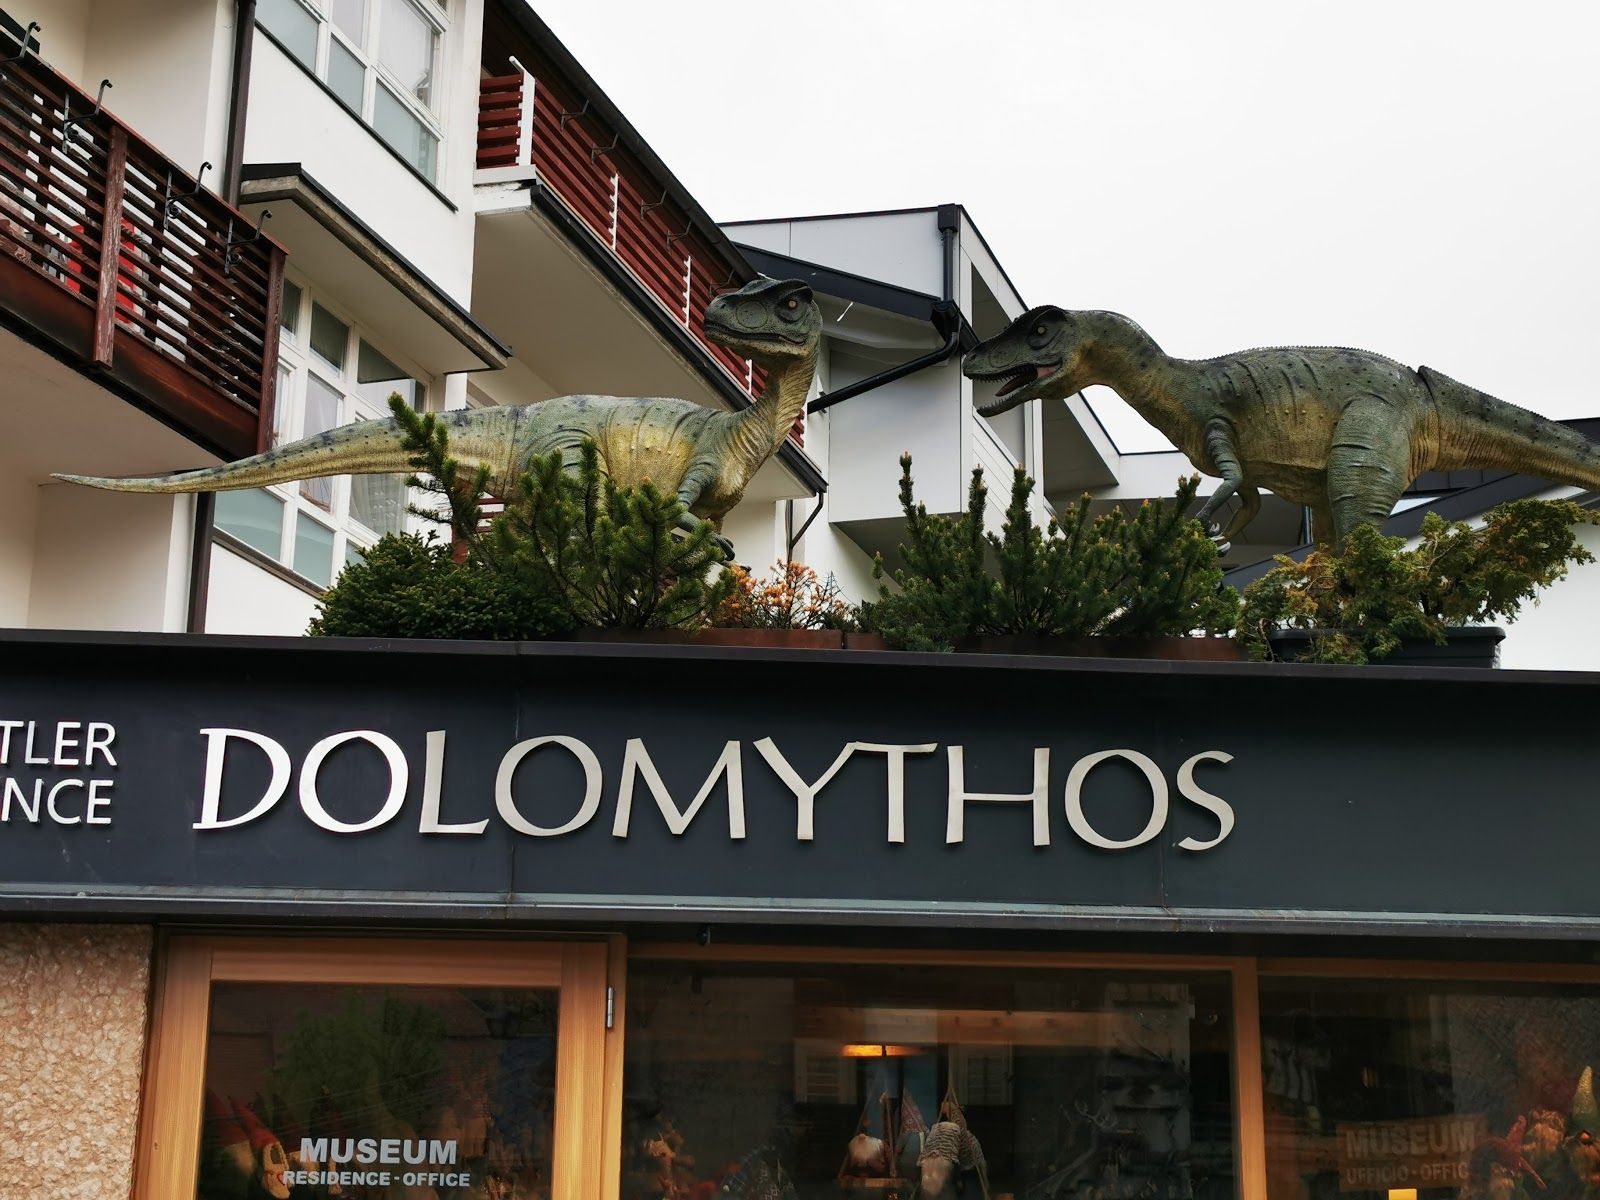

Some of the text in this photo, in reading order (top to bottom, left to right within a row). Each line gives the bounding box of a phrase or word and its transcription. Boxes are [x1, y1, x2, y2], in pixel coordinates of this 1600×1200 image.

[0, 720, 118, 766] TLER
[193, 728, 1235, 851] DOLOMYTHOS
[300, 1138, 457, 1165] MUSEUM
[1346, 1121, 1475, 1159] MUSEUM
[1420, 1162, 1471, 1181] OFFIC
